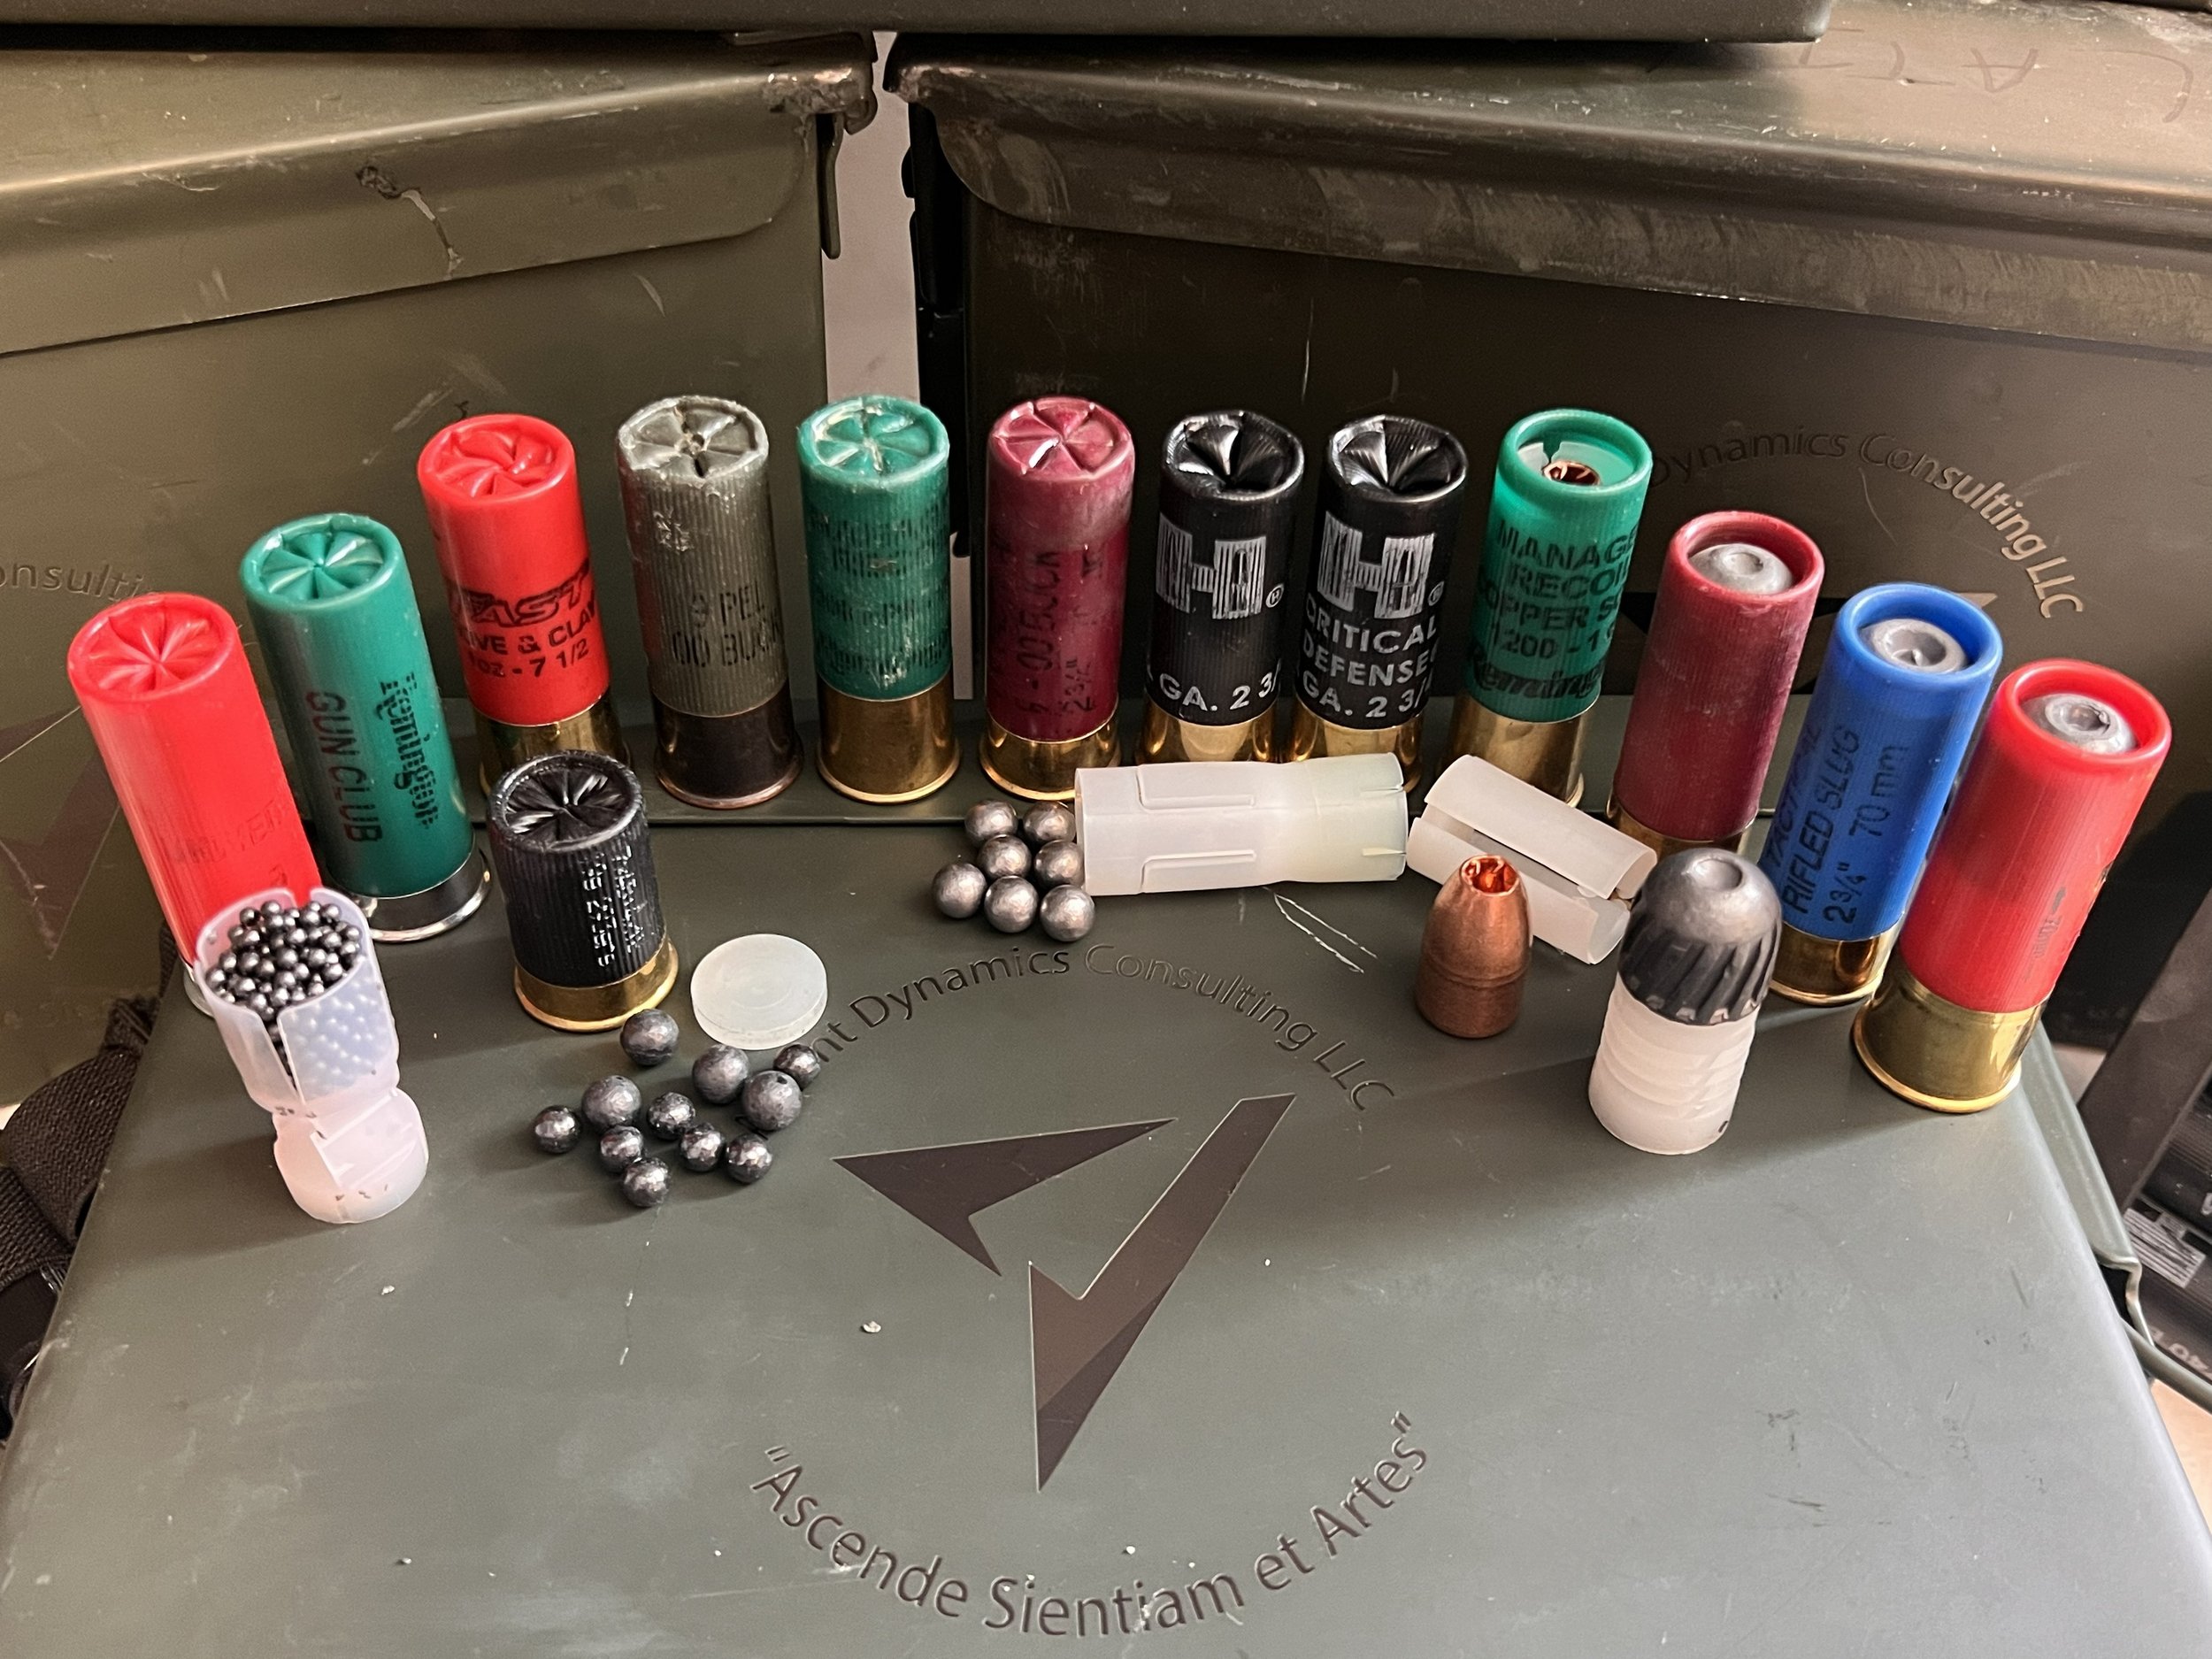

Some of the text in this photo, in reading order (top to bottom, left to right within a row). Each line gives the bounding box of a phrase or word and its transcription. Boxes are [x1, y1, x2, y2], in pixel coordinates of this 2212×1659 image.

[1650, 426, 2085, 619] Dynamics Consulting LLC
[518, 634, 541, 654] &
[1306, 592, 1437, 655] CRITICAL
[529, 656, 547, 678] 7
[556, 637, 589, 669] 1/2
[1303, 628, 1429, 687] DEFENSE
[1159, 672, 1218, 711] GA.
[1229, 685, 1251, 710] 2
[1302, 670, 1354, 717] GA.
[1365, 695, 1388, 718] 2
[307, 691, 383, 841] GUN CLUB
[1782, 725, 1860, 915] RIFLED SLUG
[849, 946, 1071, 1029] Dynamics
[1084, 942, 1320, 1053] Consulting
[1313, 1040, 1397, 1112] LLC
[751, 1409, 1430, 1637] "Ascende Sientiam et Artes"
